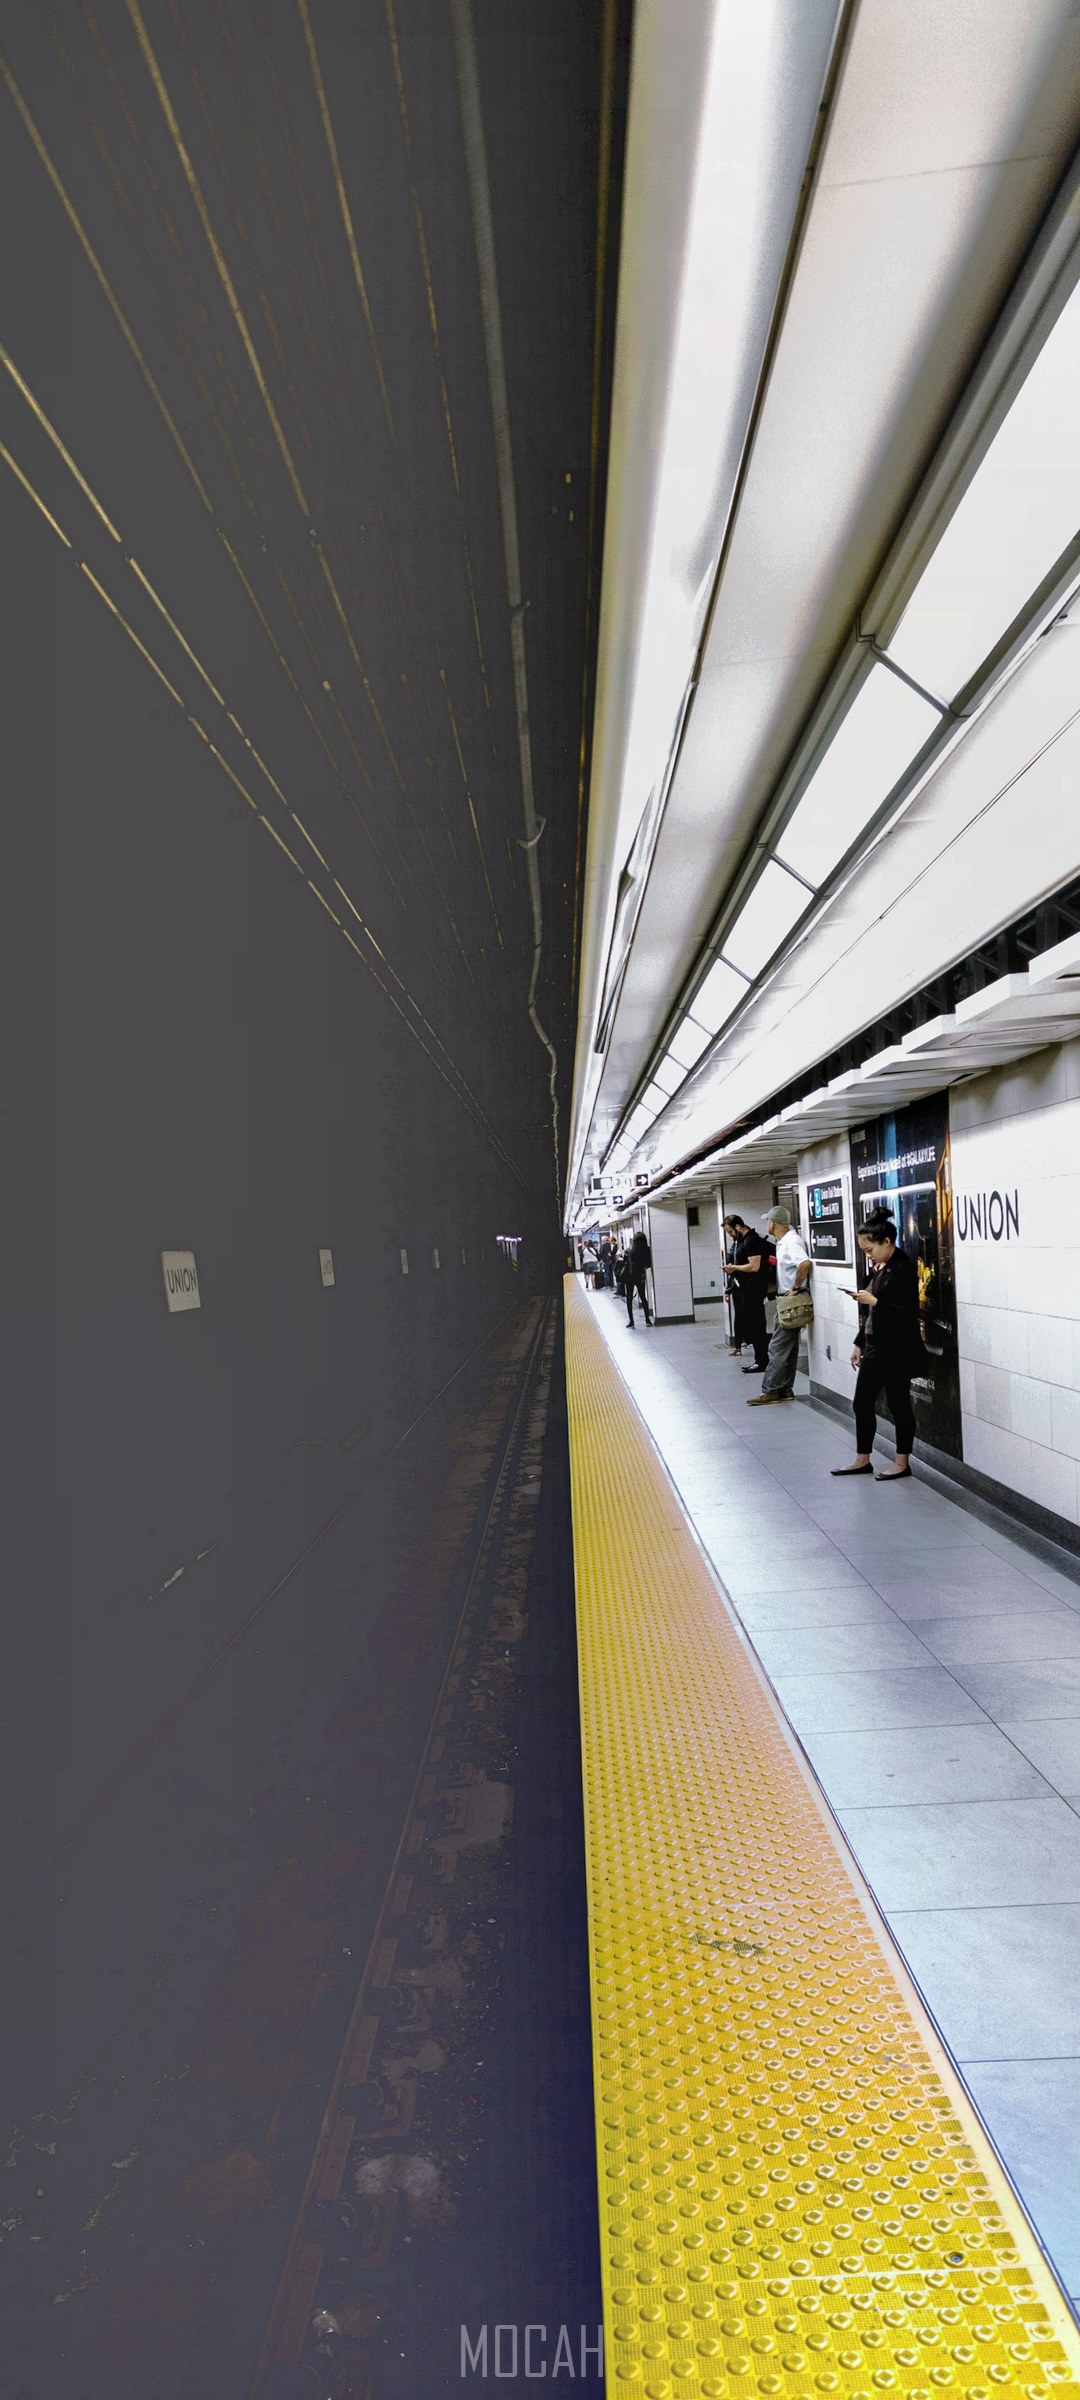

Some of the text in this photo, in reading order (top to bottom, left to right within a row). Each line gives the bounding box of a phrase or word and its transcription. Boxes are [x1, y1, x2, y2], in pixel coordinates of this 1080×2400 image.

[858, 1163, 877, 1182] Experience
[956, 1189, 1019, 1241] UNION
[166, 1267, 197, 1294] UNION
